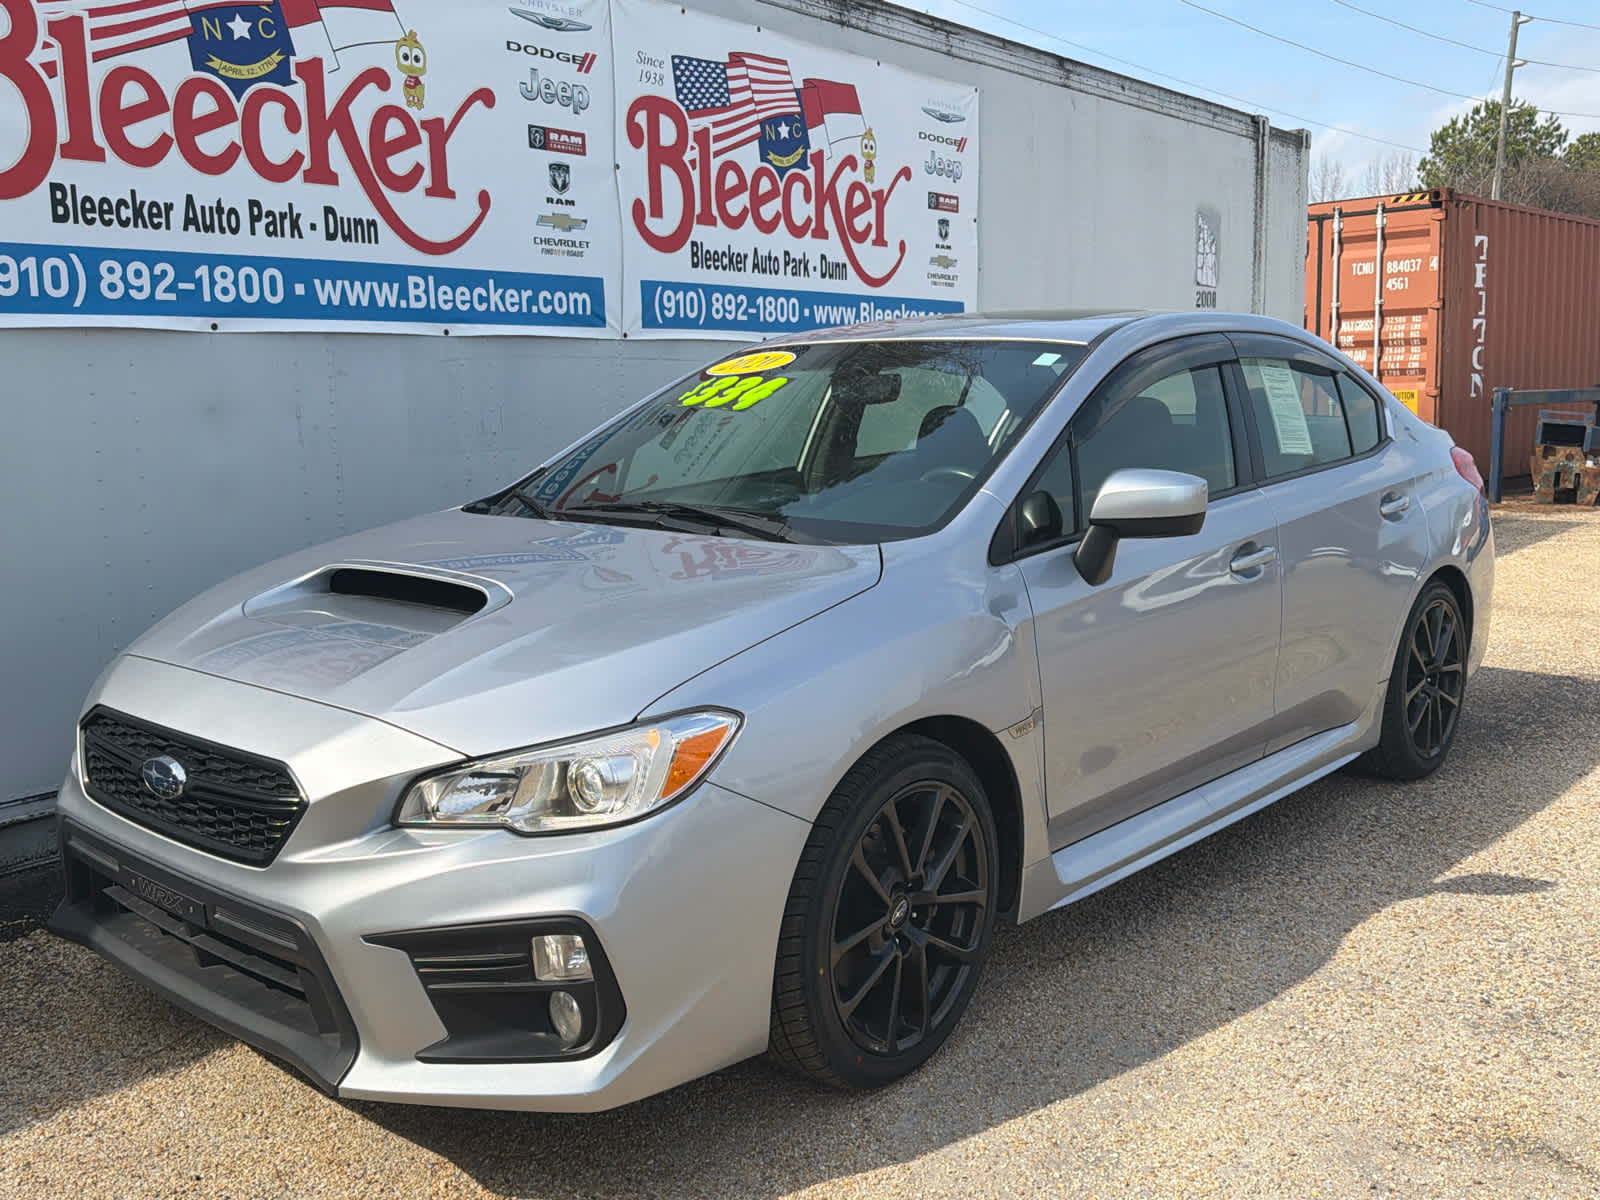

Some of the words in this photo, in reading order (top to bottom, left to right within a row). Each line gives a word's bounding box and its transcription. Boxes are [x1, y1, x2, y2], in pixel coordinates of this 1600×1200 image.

[201, 16, 222, 40] N
[258, 17, 276, 38] C
[506, 40, 585, 65] DODGE
[635, 50, 665, 69] Since
[639, 69, 665, 87] 1938
[519, 67, 590, 115] Jeep
[549, 132, 583, 144] RAM
[765, 124, 776, 141] N
[792, 122, 802, 138] C
[918, 131, 961, 147] DODGE
[924, 150, 962, 184] Jeep
[545, 196, 576, 207] RAM
[626, 95, 912, 288] Bleecker
[48, 181, 174, 231] Bleecker
[182, 193, 241, 236] Auto
[247, 198, 304, 240] Park
[322, 205, 379, 245] Dunn
[533, 236, 591, 249] CHEVROLET
[690, 240, 749, 273] Bleecker
[752, 247, 780, 276] Auto
[783, 250, 810, 278] Park
[820, 253, 848, 281] Dunn
[1386, 258, 1423, 274] 884037
[99, 259, 285, 305] 892-1800
[313, 275, 592, 316] www.Bleecker.com
[1386, 276, 1409, 291] 45G1
[654, 286, 706, 325] (910)
[711, 292, 799, 324] 892-1800
[1393, 391, 1415, 401] AUTION
[136, 877, 186, 914] WRX
